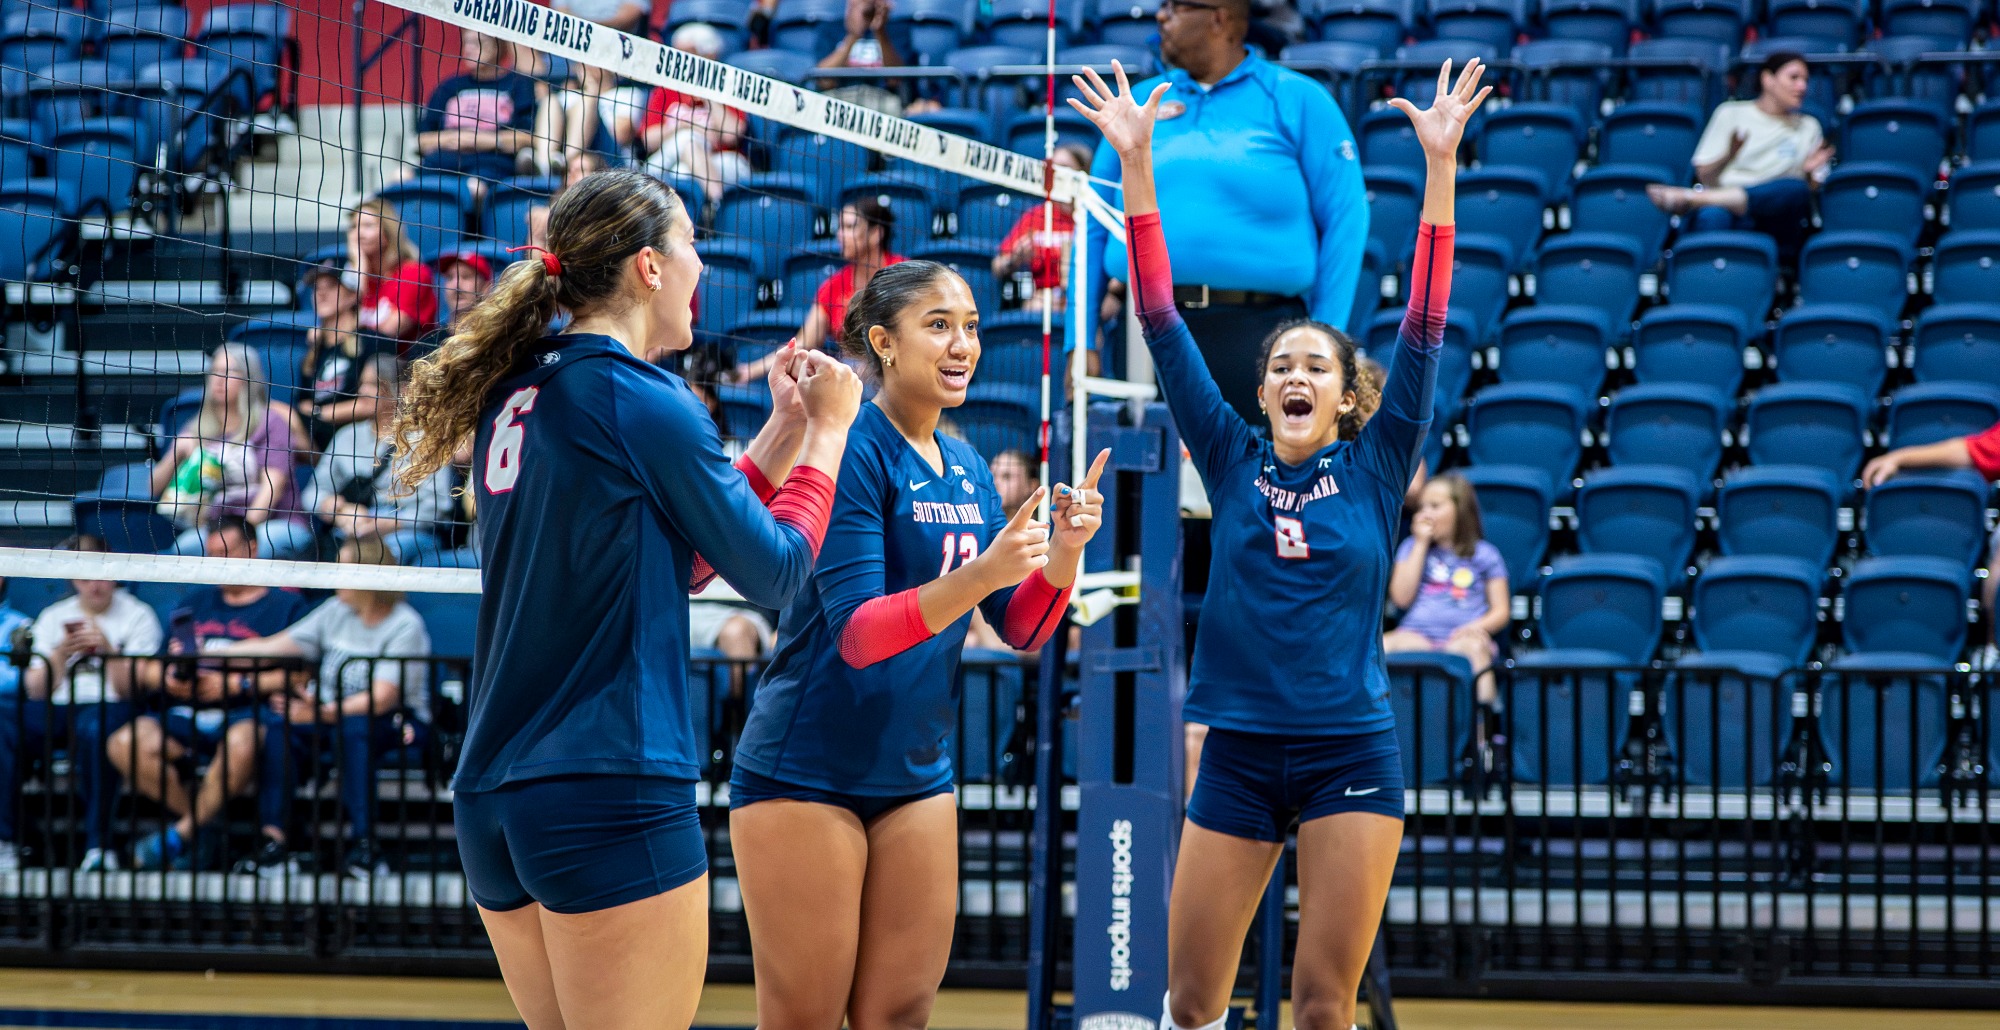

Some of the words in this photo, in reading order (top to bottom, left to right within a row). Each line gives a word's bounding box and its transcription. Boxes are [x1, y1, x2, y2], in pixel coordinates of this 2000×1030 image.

[543, 10, 593, 53] EAGLES
[656, 47, 727, 93] SCREAMING
[484, 385, 540, 495] 6
[1253, 475, 1297, 511] SOUERN
[1295, 474, 1340, 513] IIANA
[1108, 819, 1135, 897] sports
[1106, 897, 1133, 992] imports
